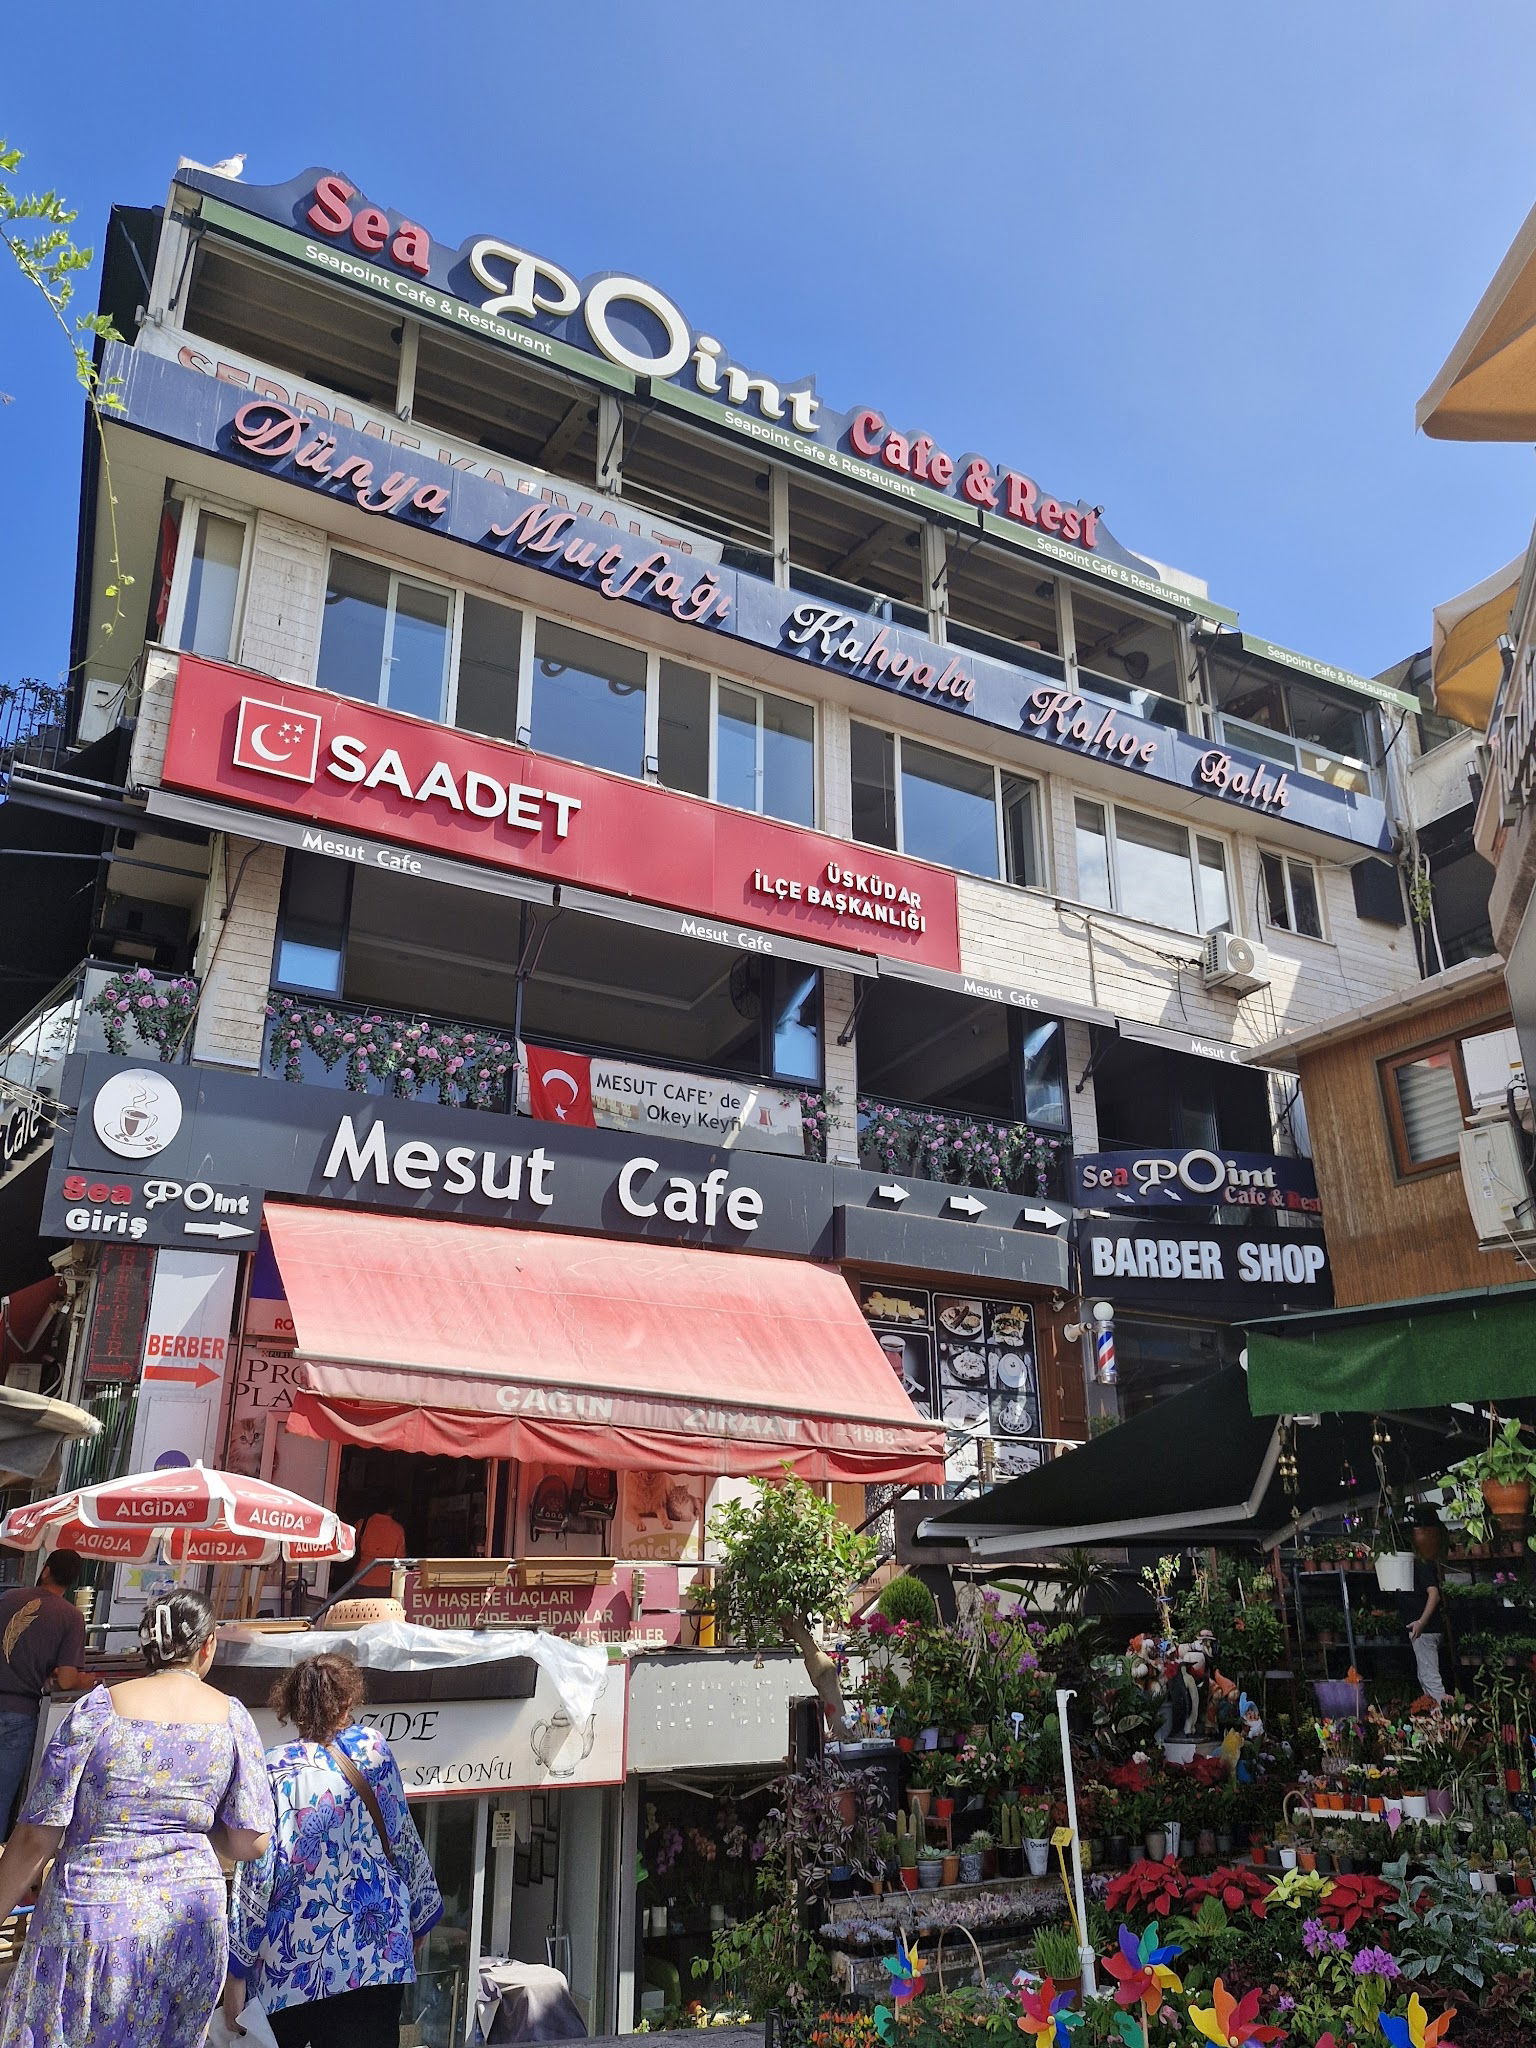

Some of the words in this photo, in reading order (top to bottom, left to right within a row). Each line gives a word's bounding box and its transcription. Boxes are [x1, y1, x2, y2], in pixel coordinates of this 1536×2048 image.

[305, 244, 391, 290] Seapoint
[394, 281, 437, 309] Cafe
[439, 300, 453, 316] &
[457, 307, 553, 356] Restaurant
[307, 176, 430, 275] Sea
[850, 411, 954, 487] Cafe
[962, 458, 999, 510] &
[1006, 473, 1100, 548] Rest
[724, 411, 791, 448] Seapoint
[793, 440, 826, 462] Cafe
[828, 453, 839, 467] &
[842, 458, 917, 498] Restaurant
[1037, 537, 1091, 568] Seapoint
[1092, 559, 1119, 579] Cafe
[1120, 569, 1129, 583] &
[1131, 574, 1192, 608] Restaurant
[234, 400, 450, 514] Dünya
[491, 502, 733, 622] Mutfağı
[788, 603, 977, 702] Kahvaltı
[1029, 687, 1159, 764] Kahve
[1200, 749, 1290, 808] Balık
[1267, 645, 1313, 672] Seapoint
[1313, 663, 1338, 680] Cafe
[1338, 671, 1346, 683] &
[1347, 675, 1399, 703] Restaurant
[326, 734, 583, 840] SAADET
[301, 830, 366, 862] Mesut
[376, 849, 423, 876] Cafe
[754, 868, 802, 900] İLÇE
[806, 885, 927, 934] BAŞKANLIĞI
[825, 860, 923, 910] ÜSKÜDAR
[680, 918, 729, 944] Mesut
[736, 933, 773, 954] Cafe
[963, 979, 1003, 1002] Mesut
[1009, 990, 1040, 1009] Cafe
[1190, 1039, 1225, 1060] Mesut
[596, 1072, 658, 1096] MESUT
[720, 1093, 741, 1109] de
[646, 1104, 692, 1128] Okey
[698, 1112, 741, 1134] Keyfi
[62, 1175, 134, 1206] Sea
[322, 1115, 555, 1206] Mesut
[617, 1156, 764, 1231] Cafe
[1082, 1165, 1129, 1189] Sea
[1223, 1185, 1267, 1206] Cafe
[1269, 1188, 1285, 1207] &
[65, 1208, 148, 1241] Giriş
[1091, 1237, 1224, 1281] BARBER
[1236, 1242, 1325, 1284] SHOP
[147, 1334, 225, 1360] BERBER
[854, 1427, 896, 1446] 1983
[412, 1593, 434, 1609] EV
[438, 1590, 501, 1611] HAŞERE
[505, 1588, 574, 1609] İLAÇLARI
[412, 1612, 471, 1630] TOHUM
[539, 1609, 614, 1626] FİDANLAR
[413, 1756, 512, 1787] SALONU
